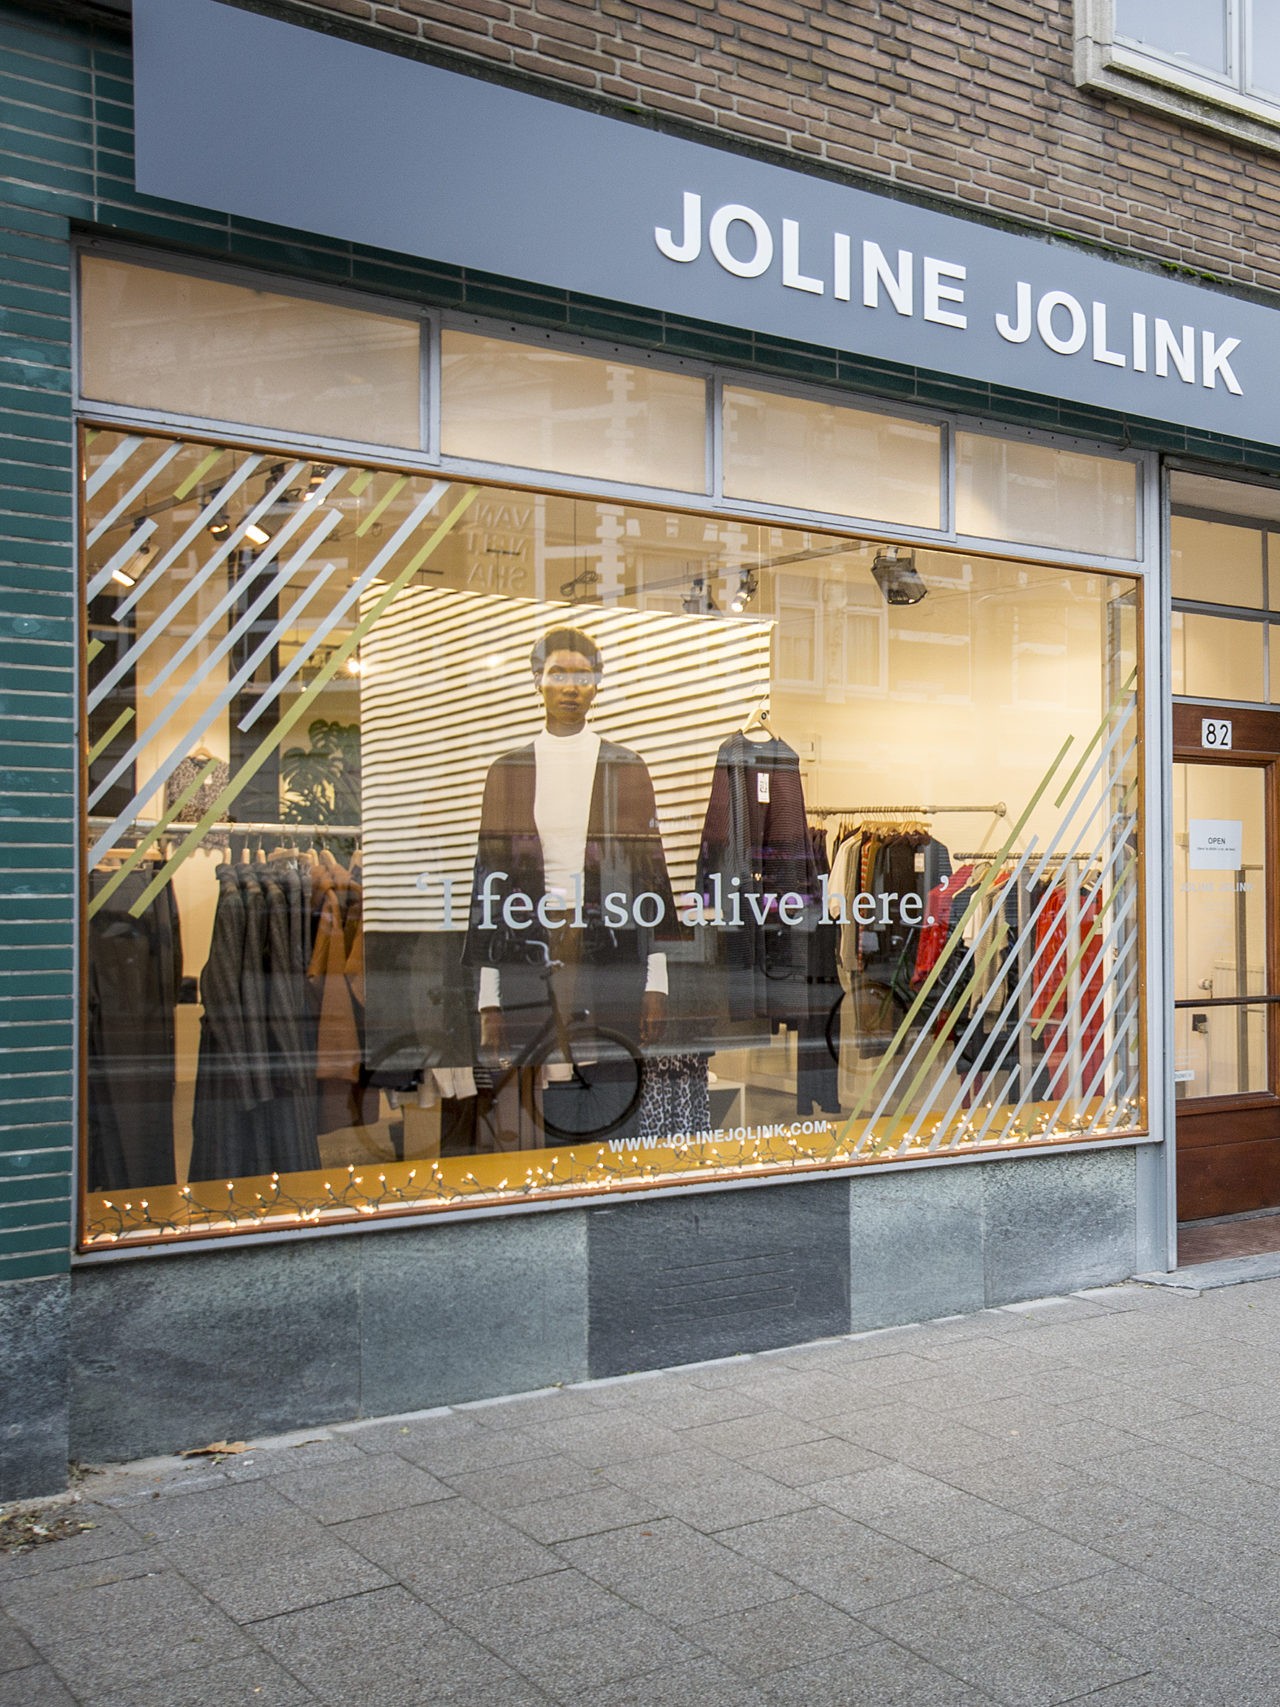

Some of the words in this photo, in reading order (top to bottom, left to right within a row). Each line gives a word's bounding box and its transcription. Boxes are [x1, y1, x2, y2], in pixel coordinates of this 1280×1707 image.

[654, 191, 967, 330] JOLINE
[995, 281, 1244, 396] JOLINK
[1206, 722, 1229, 747] 82
[1207, 836, 1226, 846] OPEN
[476, 871, 588, 931] feel
[604, 888, 667, 929] so
[681, 872, 804, 928] alive
[608, 1119, 828, 1154] WWW.JOLINEJOLINK.COM
